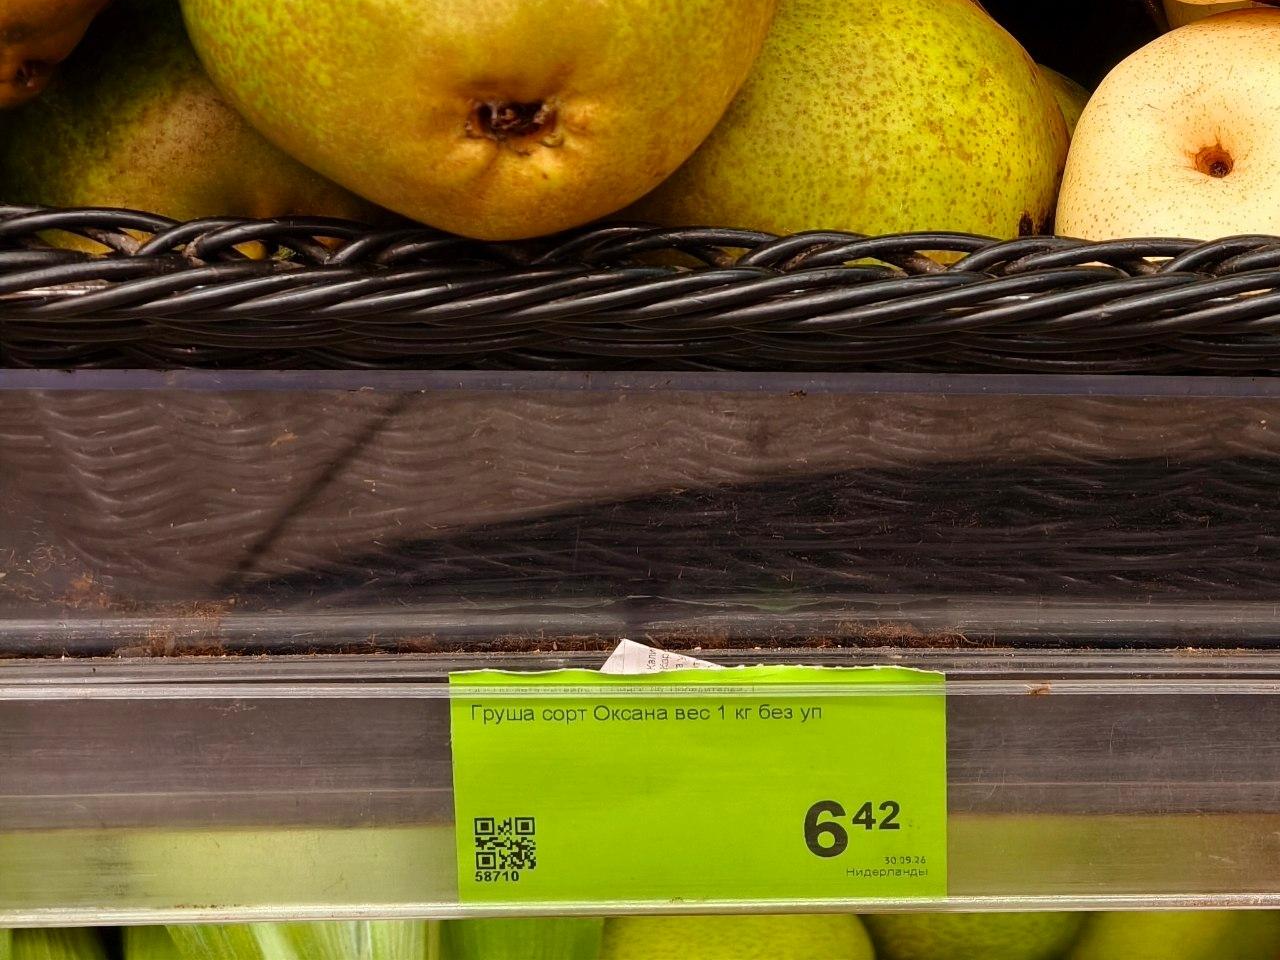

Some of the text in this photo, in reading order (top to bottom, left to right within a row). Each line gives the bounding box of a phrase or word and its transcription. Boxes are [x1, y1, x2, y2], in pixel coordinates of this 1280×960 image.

[471, 703, 822, 725] Груша сорт Оксана вес 1 кг без уп
[803, 799, 901, 858] 6 42
[474, 870, 520, 883] 58710
[845, 866, 929, 880] Нидерланды
